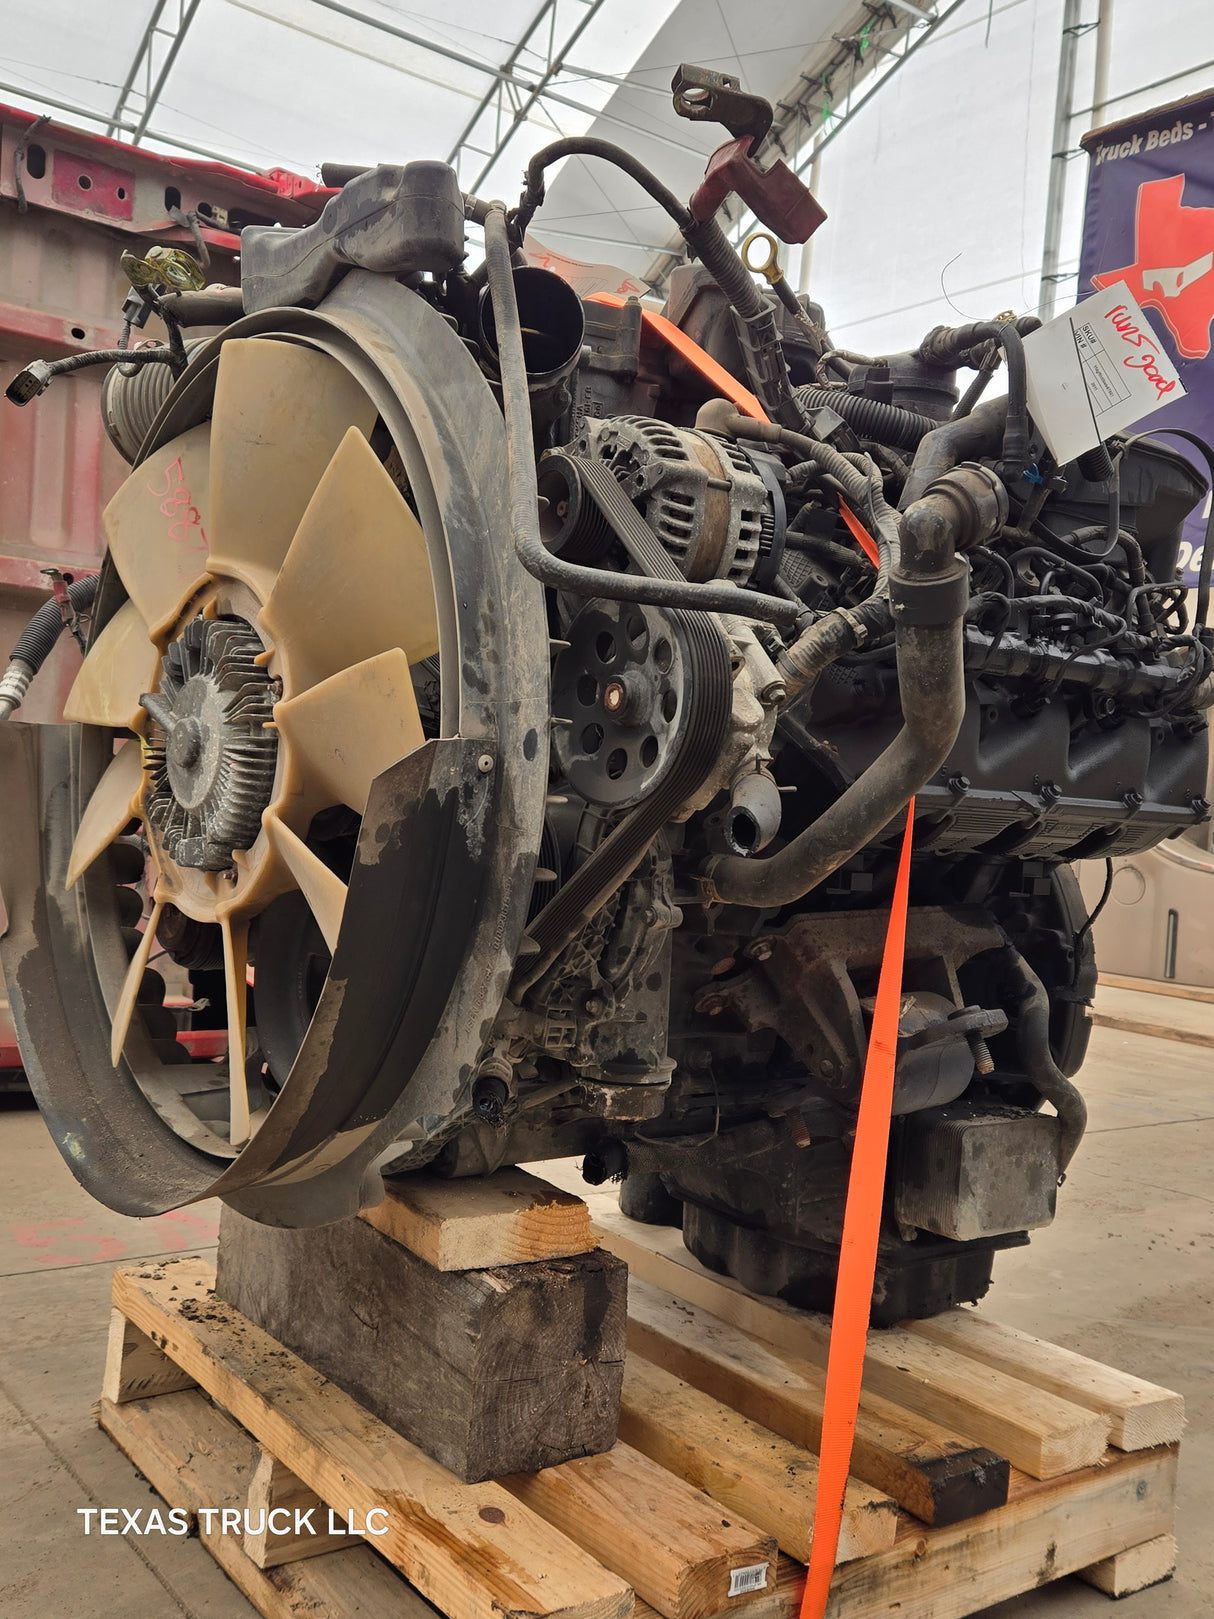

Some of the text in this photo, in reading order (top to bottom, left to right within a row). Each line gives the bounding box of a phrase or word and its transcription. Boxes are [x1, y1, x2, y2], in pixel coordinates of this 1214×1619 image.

[1095, 134, 1144, 166] Truck
[1144, 120, 1194, 152] Beds
[1081, 325, 1097, 345] SKU#
